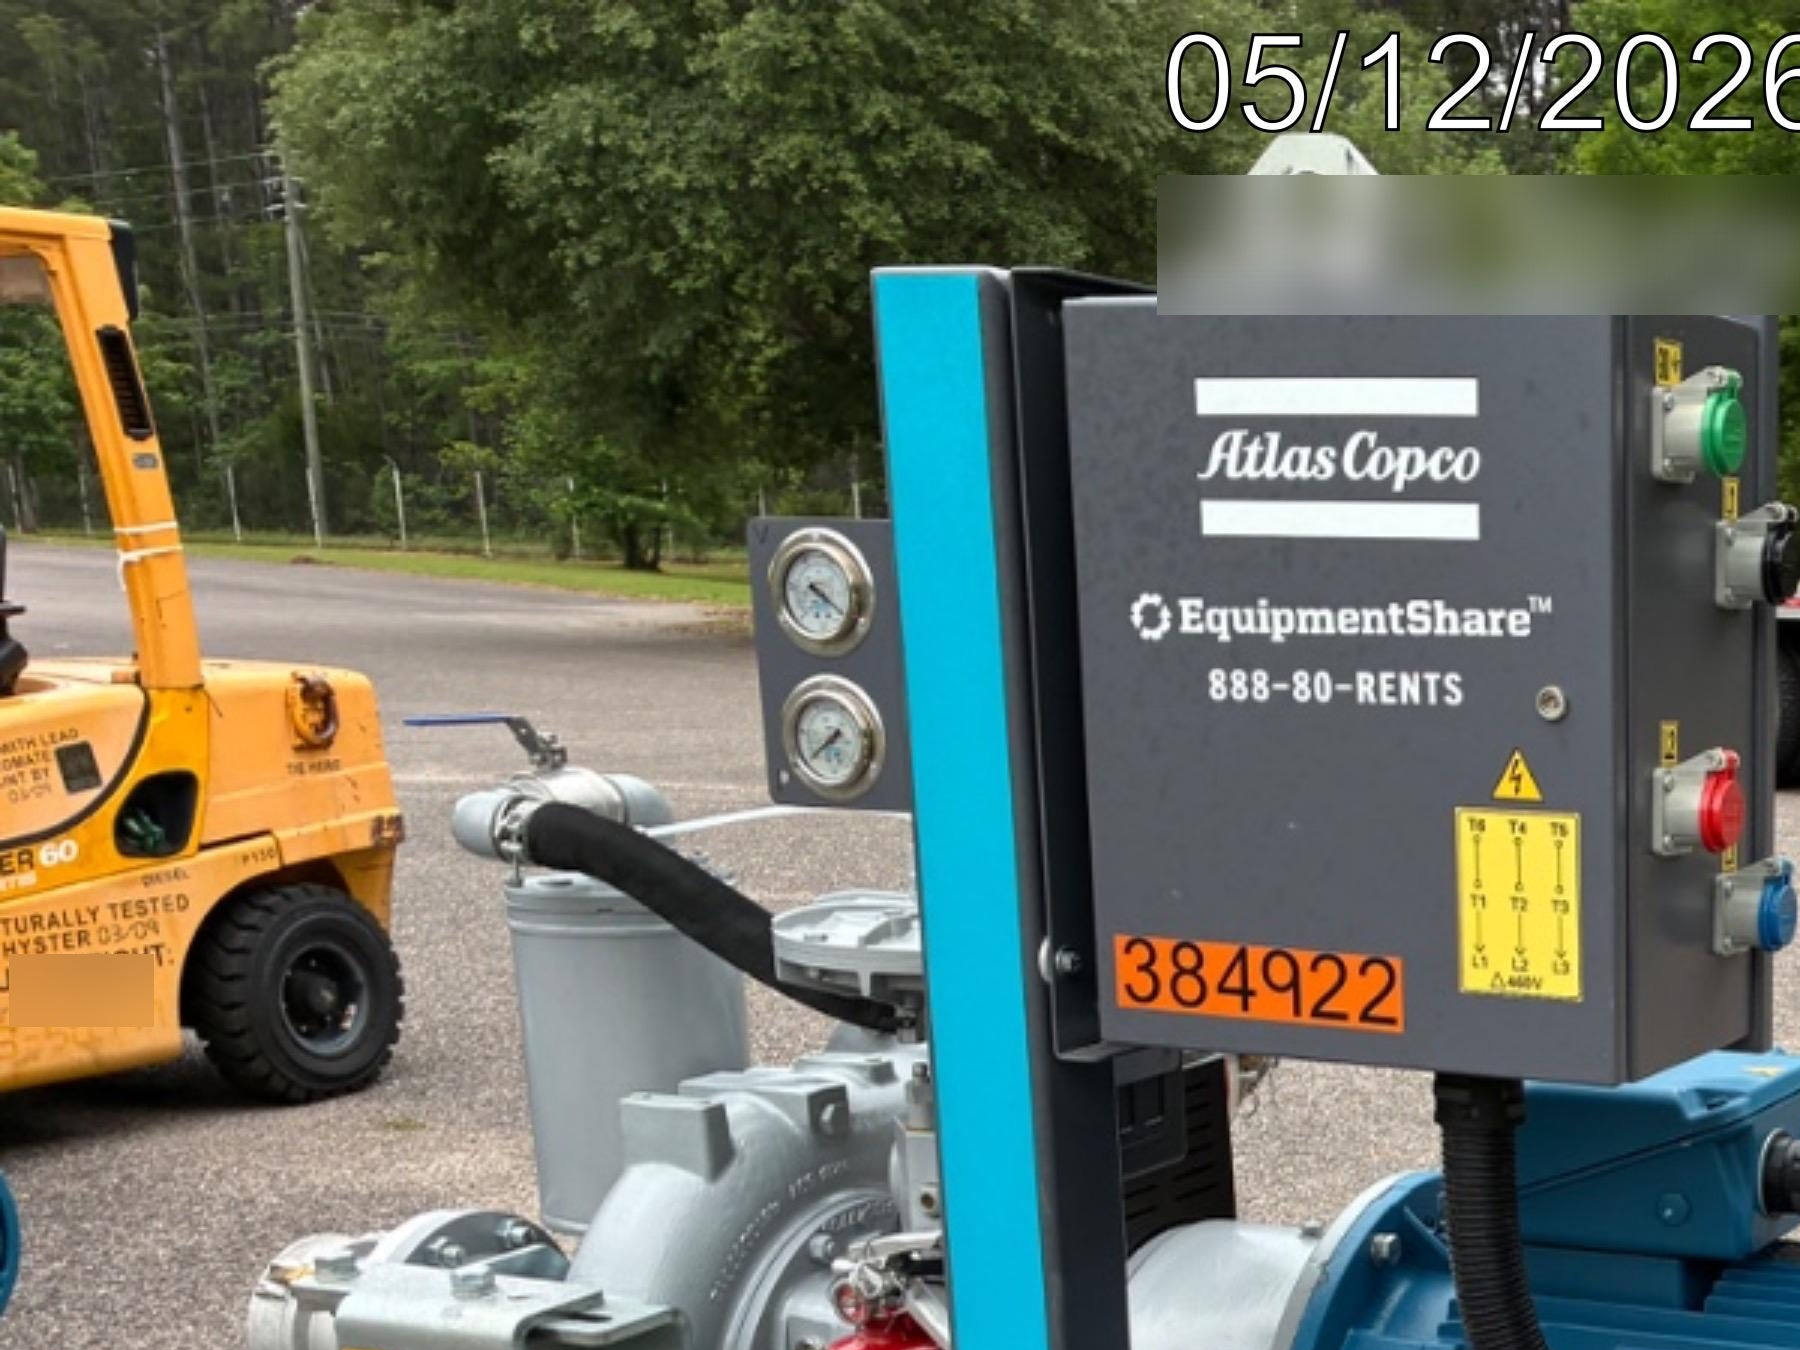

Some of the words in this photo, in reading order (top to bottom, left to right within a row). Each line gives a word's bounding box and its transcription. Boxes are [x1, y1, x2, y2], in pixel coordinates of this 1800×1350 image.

[1197, 429, 1337, 480] Atlas
[1343, 430, 1480, 493] Copco
[1207, 668, 1464, 706] 888-80-RENTS
[39, 839, 79, 868] 60
[107, 892, 191, 920] TESTED
[2, 928, 91, 957] HYSTER
[1123, 936, 1399, 1026] 384922
